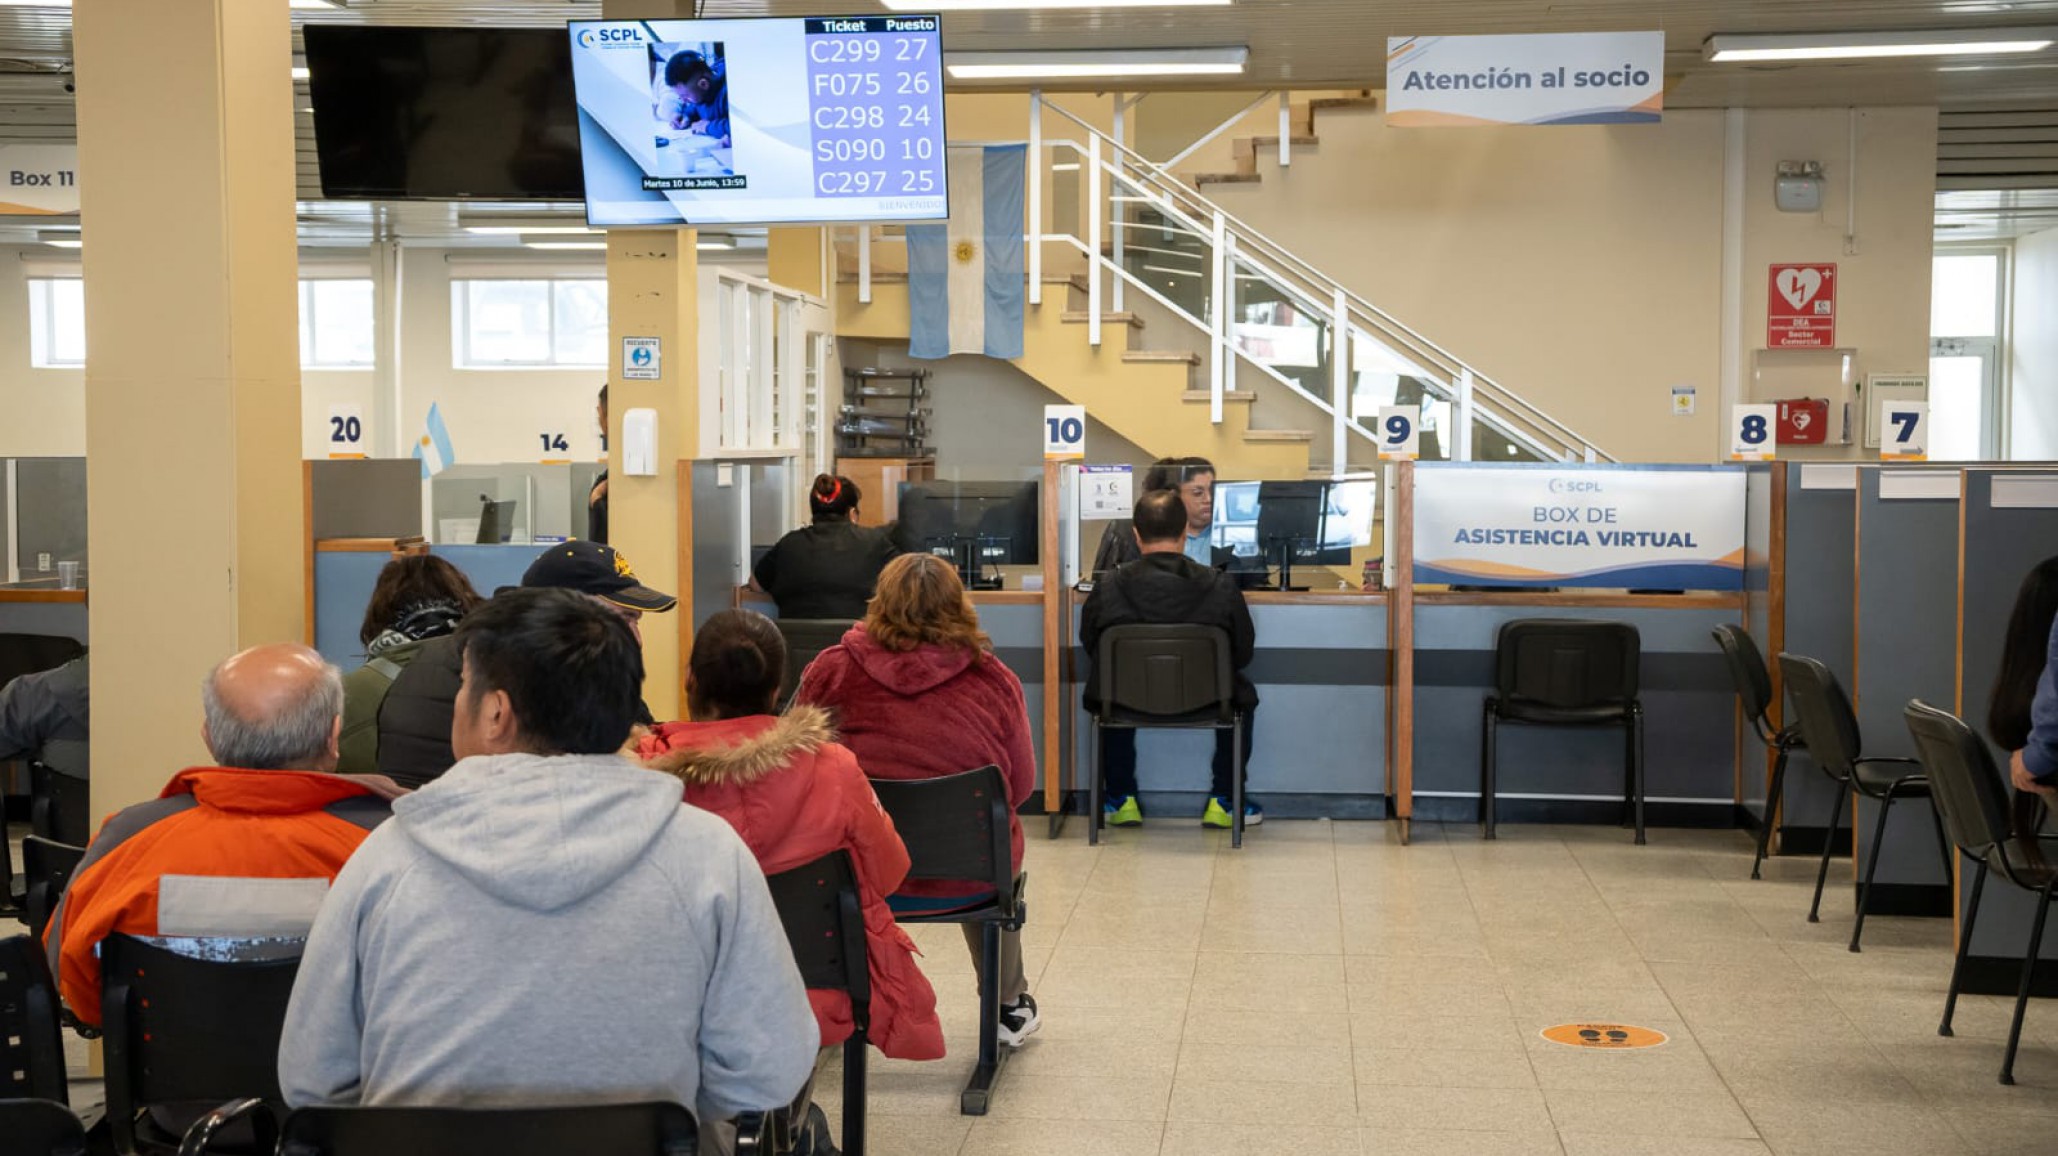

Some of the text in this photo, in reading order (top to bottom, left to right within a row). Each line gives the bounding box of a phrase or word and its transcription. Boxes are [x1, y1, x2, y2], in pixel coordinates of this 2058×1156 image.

[600, 29, 642, 41] SCPL
[823, 19, 935, 32] Ticket Puesto
[811, 39, 927, 63] C299 27
[815, 71, 930, 96] F075 26
[1403, 64, 1650, 90] Atención al socio
[815, 105, 932, 129] C298 24
[817, 138, 932, 161] S090 10
[10, 171, 74, 186] Box 11
[819, 170, 934, 194] C297 25
[330, 416, 361, 442] 20
[1047, 417, 1083, 443] 10
[1385, 415, 1411, 444] 9
[1740, 414, 1767, 444] 8
[1891, 412, 1919, 443] 7
[540, 433, 568, 451] 14
[1568, 482, 1602, 493] SCPL
[1533, 507, 1617, 523] BOX DE
[1454, 528, 1698, 548] ASISTENCIA VIRTUAL
